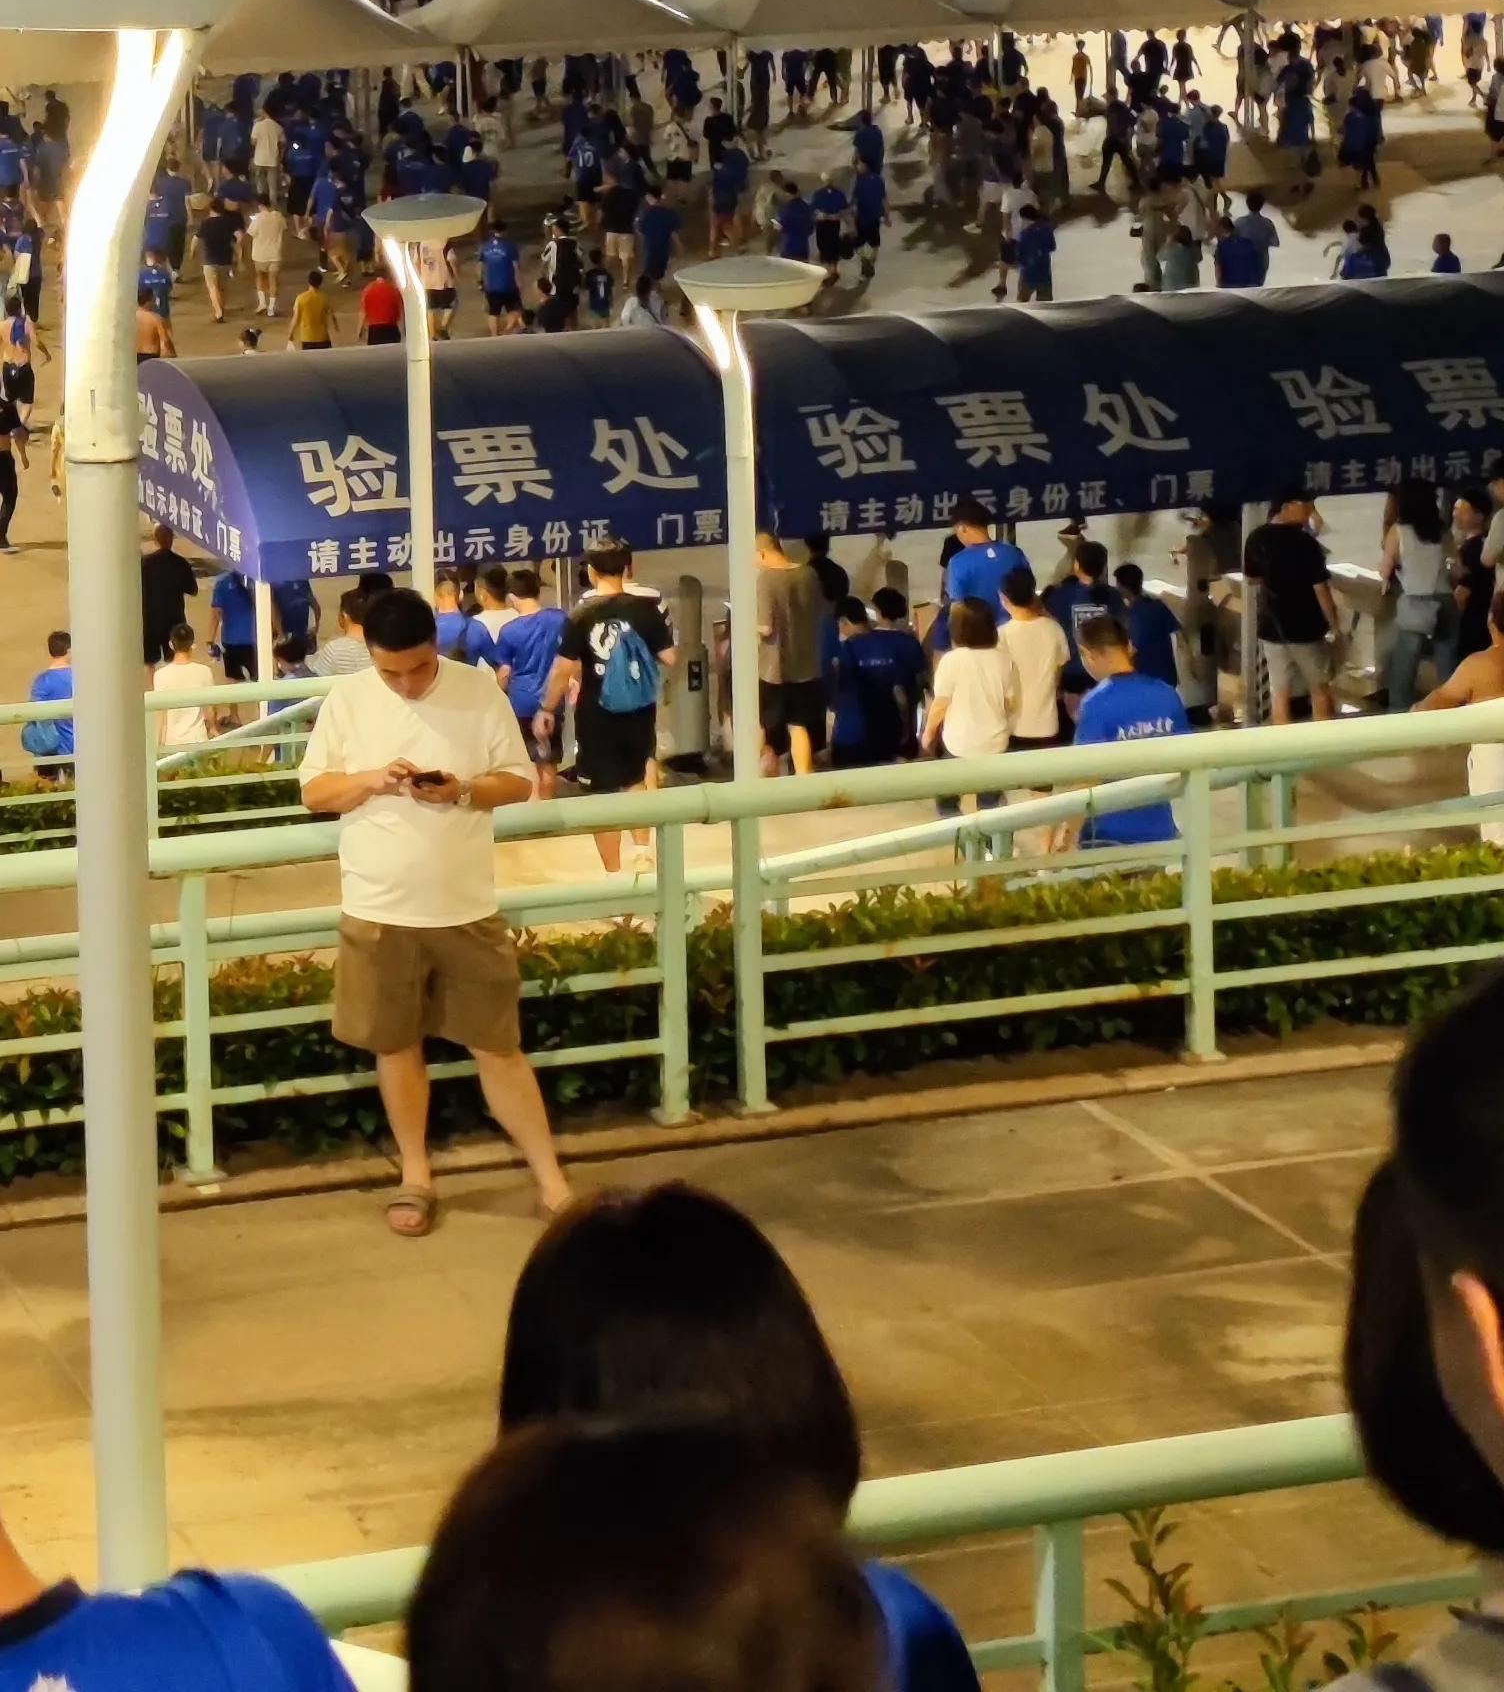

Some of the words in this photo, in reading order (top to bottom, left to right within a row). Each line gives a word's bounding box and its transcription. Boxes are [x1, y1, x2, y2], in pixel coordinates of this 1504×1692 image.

[577, 149, 595, 168] 10
[291, 416, 700, 518] 验票处
[798, 381, 1191, 480] 验票处
